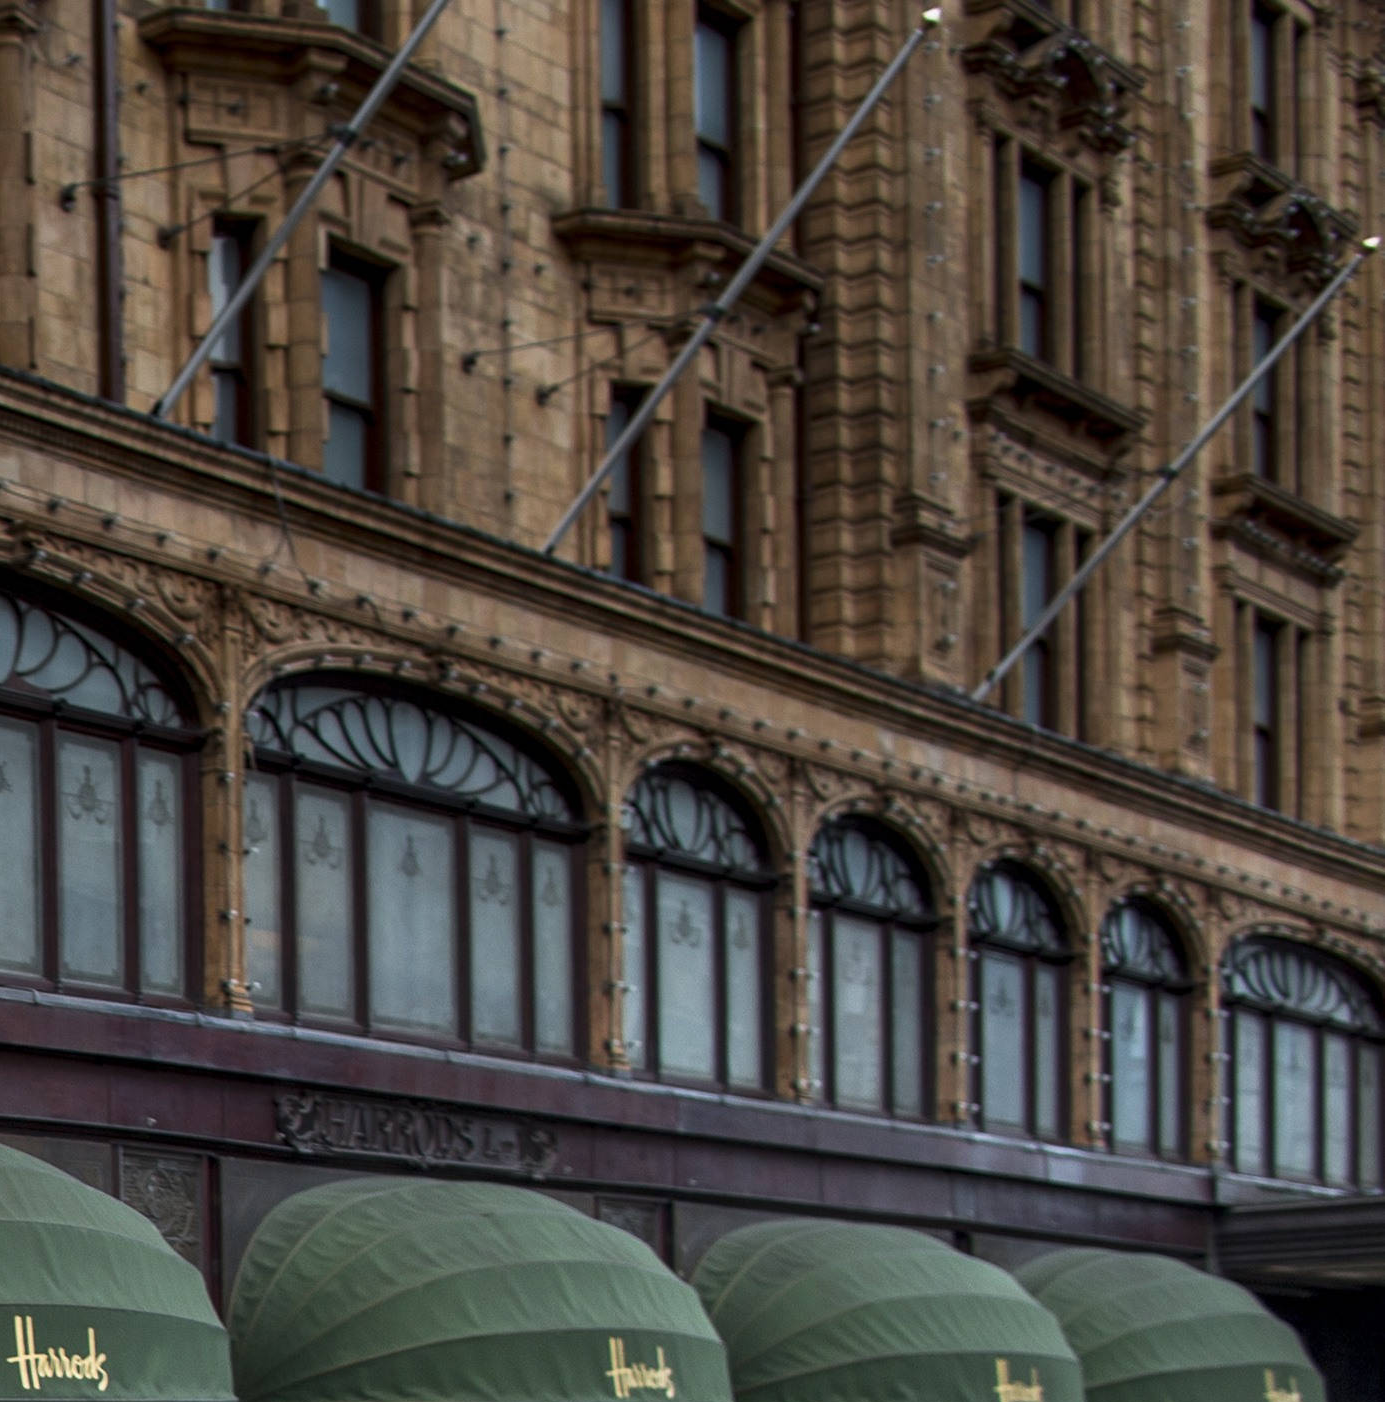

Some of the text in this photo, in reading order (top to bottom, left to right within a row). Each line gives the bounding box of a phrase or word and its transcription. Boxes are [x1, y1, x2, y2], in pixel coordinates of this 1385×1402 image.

[322, 1098, 477, 1163] HARRODS
[7, 1315, 109, 1392] Harrods
[606, 1336, 677, 1399] Harrods
